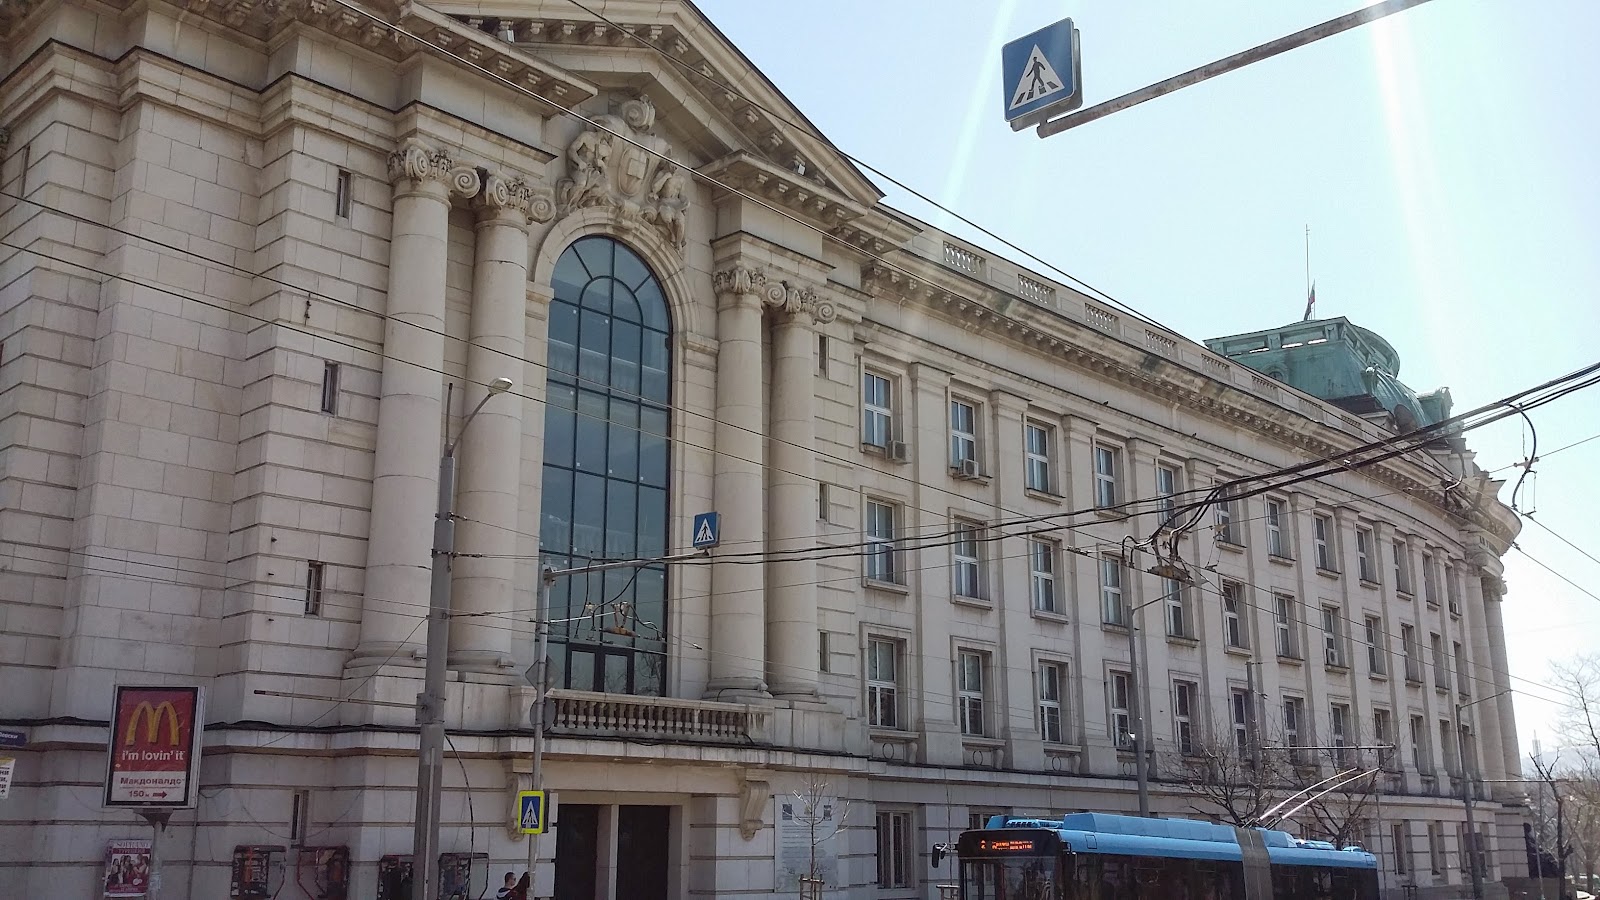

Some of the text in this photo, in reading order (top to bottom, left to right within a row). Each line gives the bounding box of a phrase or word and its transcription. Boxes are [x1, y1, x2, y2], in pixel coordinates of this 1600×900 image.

[122, 750, 139, 760] i'm
[142, 750, 174, 760] lovin'
[120, 777, 182, 785] Макдоналдс
[128, 790, 145, 798] 150
